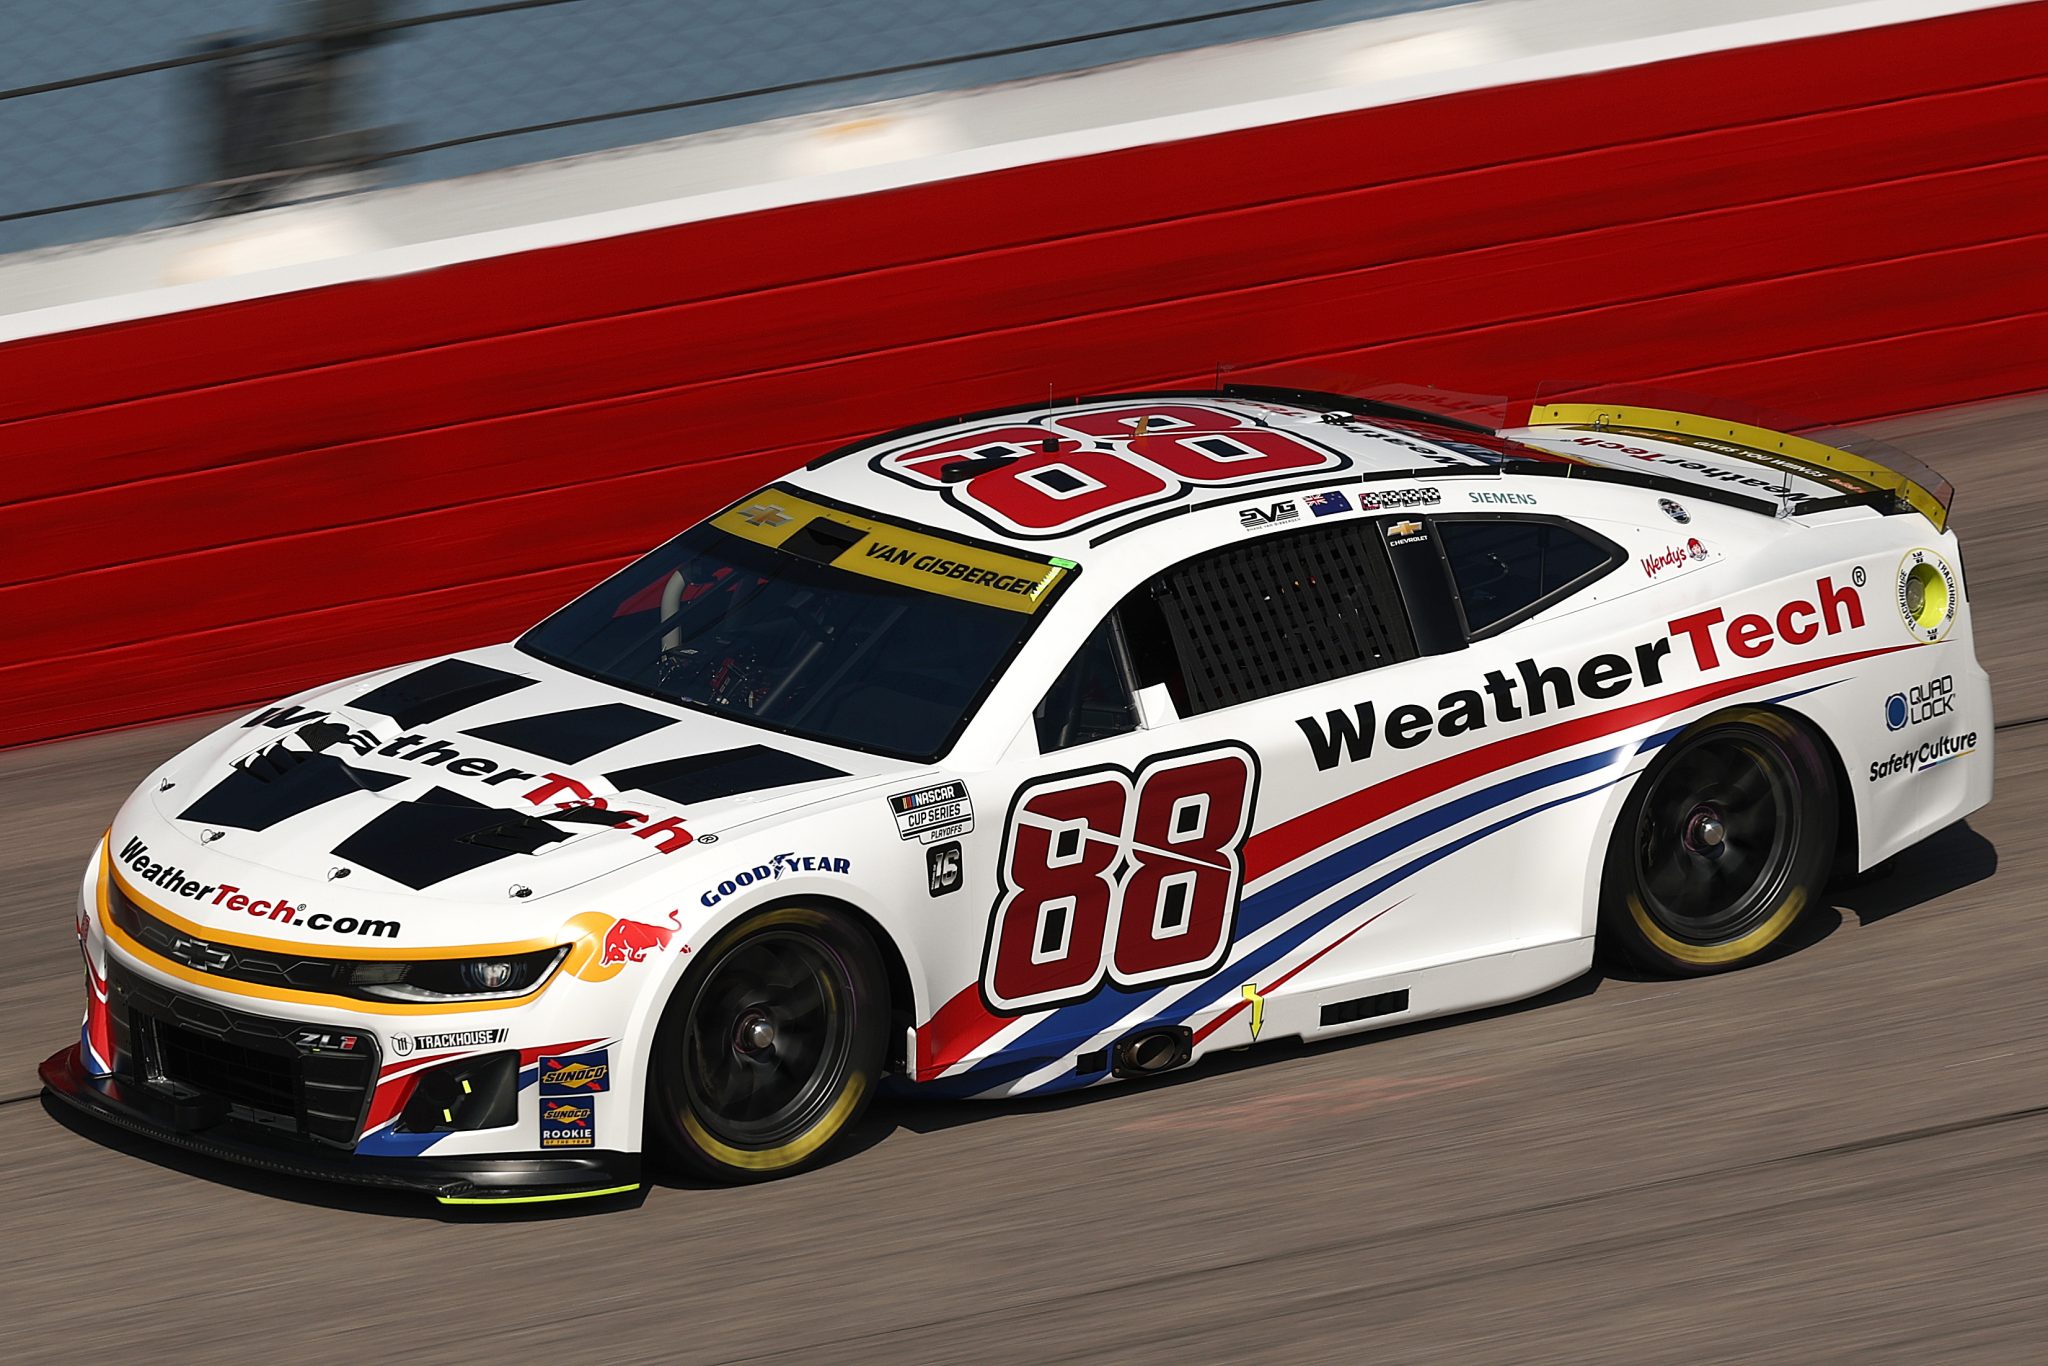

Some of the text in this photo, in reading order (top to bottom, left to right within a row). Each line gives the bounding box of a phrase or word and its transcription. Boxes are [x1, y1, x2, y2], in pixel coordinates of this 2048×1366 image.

[869, 402, 1353, 541] 88
[1468, 492, 1537, 505] SIEMENS
[1238, 499, 1297, 523] SVG
[1389, 535, 1428, 547] CHEVROLET
[865, 542, 917, 566] VAN
[1640, 545, 1687, 578] Wendy's
[1909, 674, 1953, 704] QUAD
[1910, 695, 1954, 725] LOCK
[1869, 731, 1977, 783] SafetyCulture
[915, 786, 955, 806] NASCAR
[908, 803, 961, 827] CUP SERIES
[930, 824, 963, 840] PLAYOFFS
[700, 852, 851, 908] GOODYEAR
[983, 743, 1257, 1011] 88
[418, 1029, 494, 1049] TRACKHOUSE
[544, 1067, 606, 1082] SUNOCO
[545, 1110, 589, 1118] SUNOCO
[543, 1129, 592, 1138] ROOKIE
